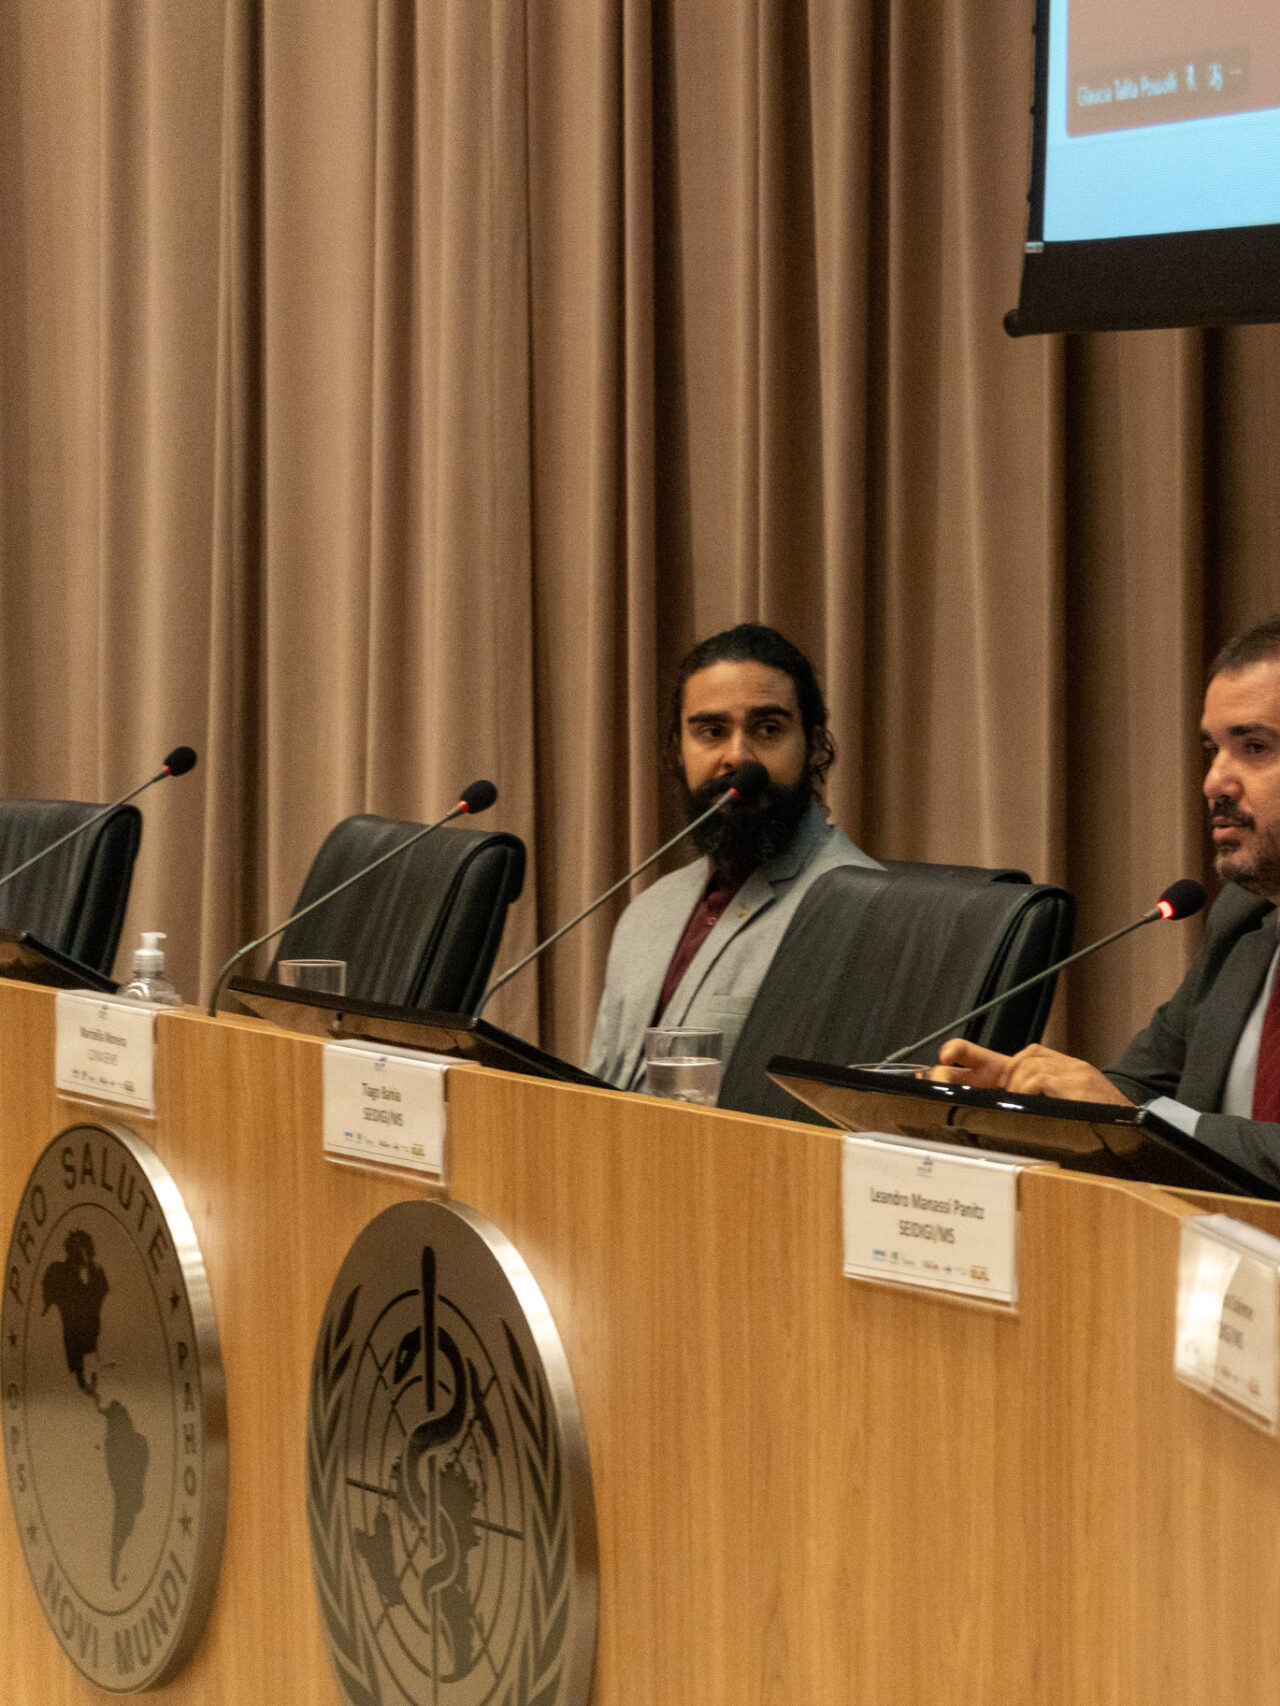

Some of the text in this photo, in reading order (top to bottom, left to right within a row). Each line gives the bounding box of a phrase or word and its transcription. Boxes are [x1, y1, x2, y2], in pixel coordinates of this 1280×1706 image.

[8, 1183, 48, 1309] PRO
[60, 1142, 169, 1276] SALUTE
[870, 1186, 986, 1220] Leandro Manassi Panitz
[177, 1341, 197, 1497] PAHO
[43, 1561, 99, 1669] NOVI
[114, 1551, 189, 1676] MUNDI
